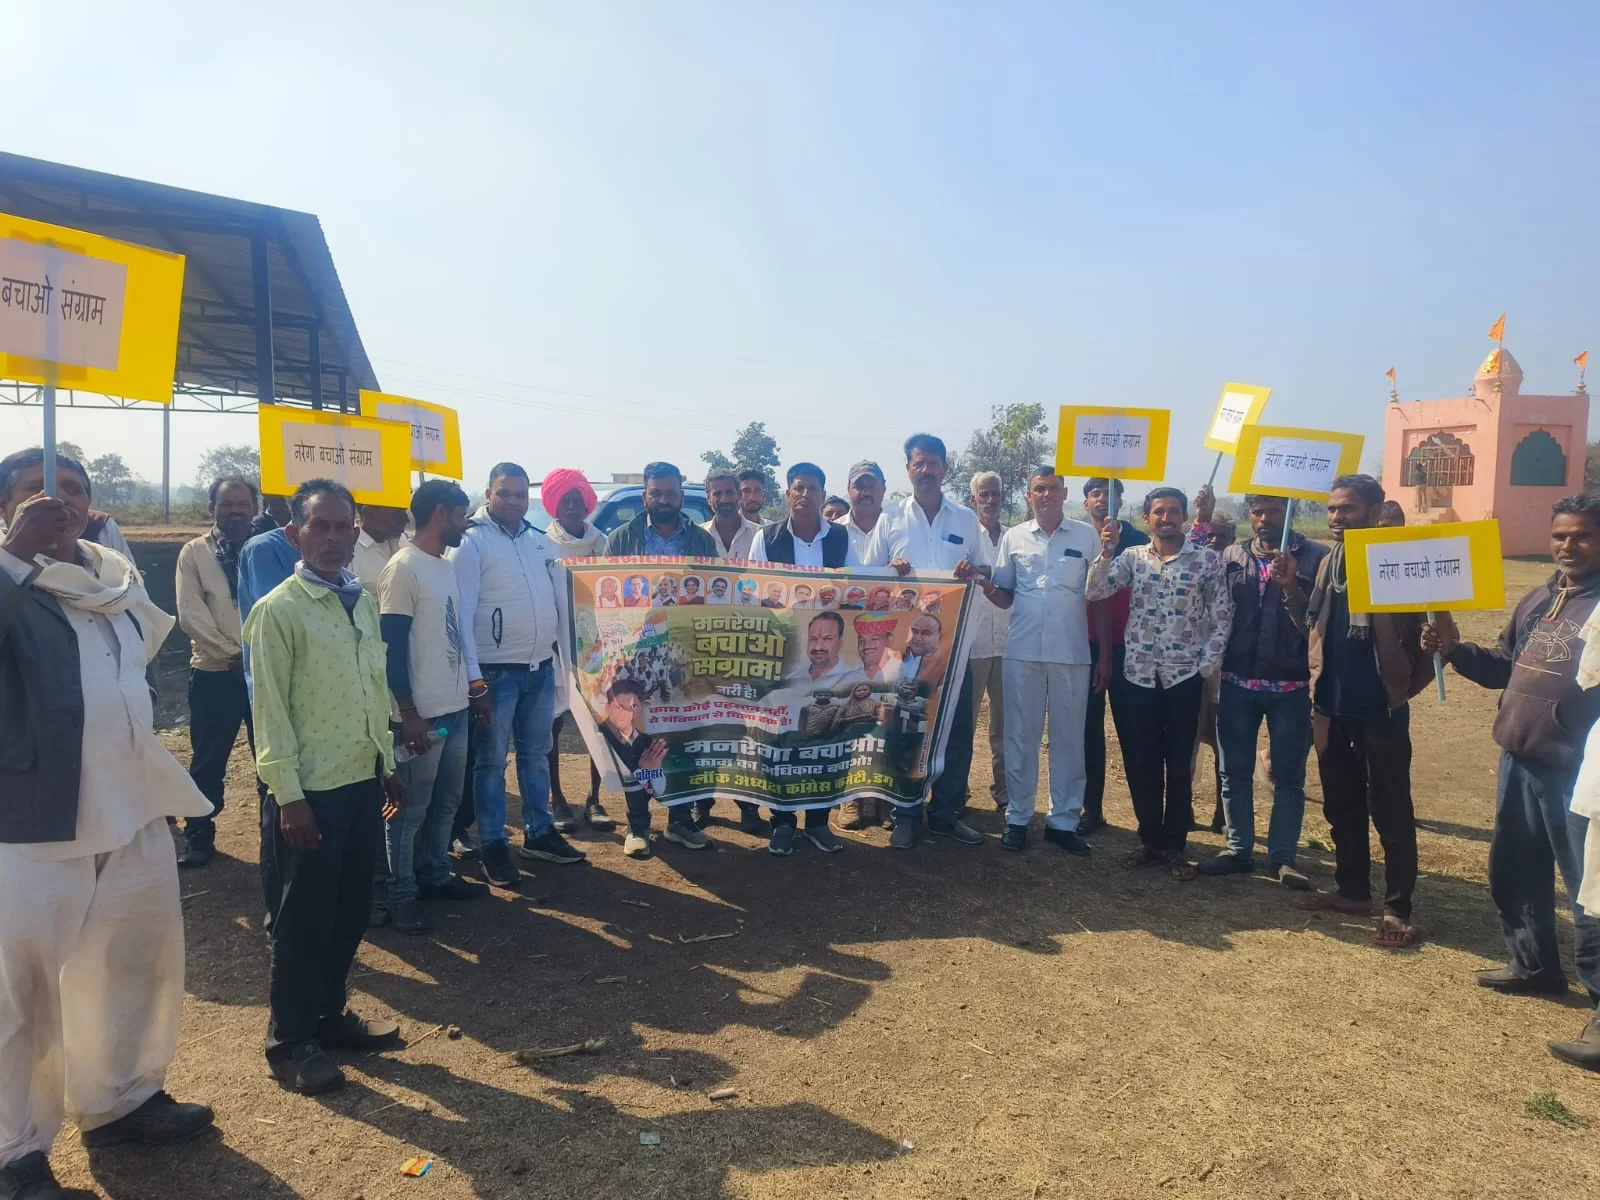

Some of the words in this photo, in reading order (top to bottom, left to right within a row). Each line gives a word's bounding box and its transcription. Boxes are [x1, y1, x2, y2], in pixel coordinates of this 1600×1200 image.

[2, 274, 53, 315] बचाओ
[61, 280, 106, 325] संग्राम
[294, 440, 315, 463] नरेगा
[319, 443, 344, 465] बचाओ
[349, 443, 373, 467] संग्राम
[1265, 448, 1284, 468] नरेगा
[1285, 452, 1308, 471] बचाओ
[1309, 452, 1331, 472] संग्राम
[1379, 558, 1399, 581] नरेगा
[1404, 556, 1430, 579] बचाओ
[1435, 553, 1461, 578] संग्राम
[693, 611, 770, 632] मनरेगा
[696, 628, 786, 657] बचाओ
[648, 706, 679, 714] काम
[683, 700, 711, 712] कोई
[684, 736, 793, 762] मनरेगा
[798, 734, 886, 761] बचाओ!
[695, 758, 733, 767] काम
[736, 759, 759, 770] का
